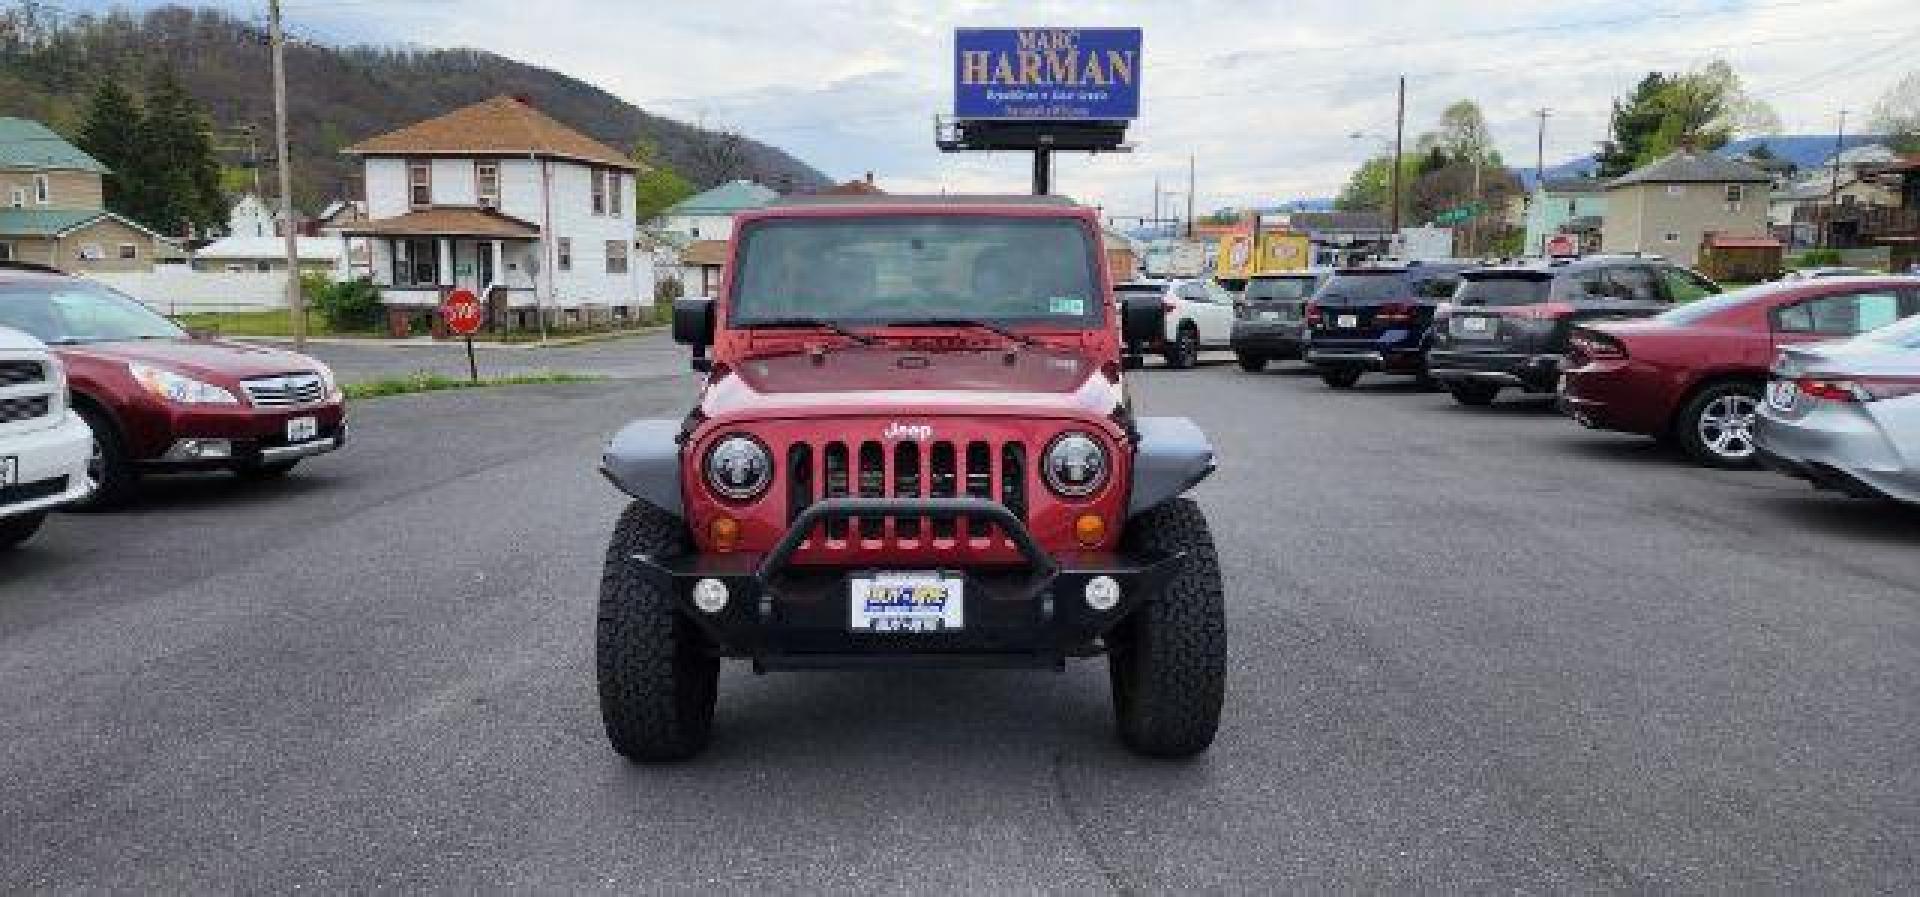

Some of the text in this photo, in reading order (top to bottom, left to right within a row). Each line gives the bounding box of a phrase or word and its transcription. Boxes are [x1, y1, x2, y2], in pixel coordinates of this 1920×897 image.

[1018, 30, 1080, 48] MARC
[961, 50, 1133, 84] HARMAN
[450, 302, 479, 320] STOP
[883, 422, 932, 441] Jeep
